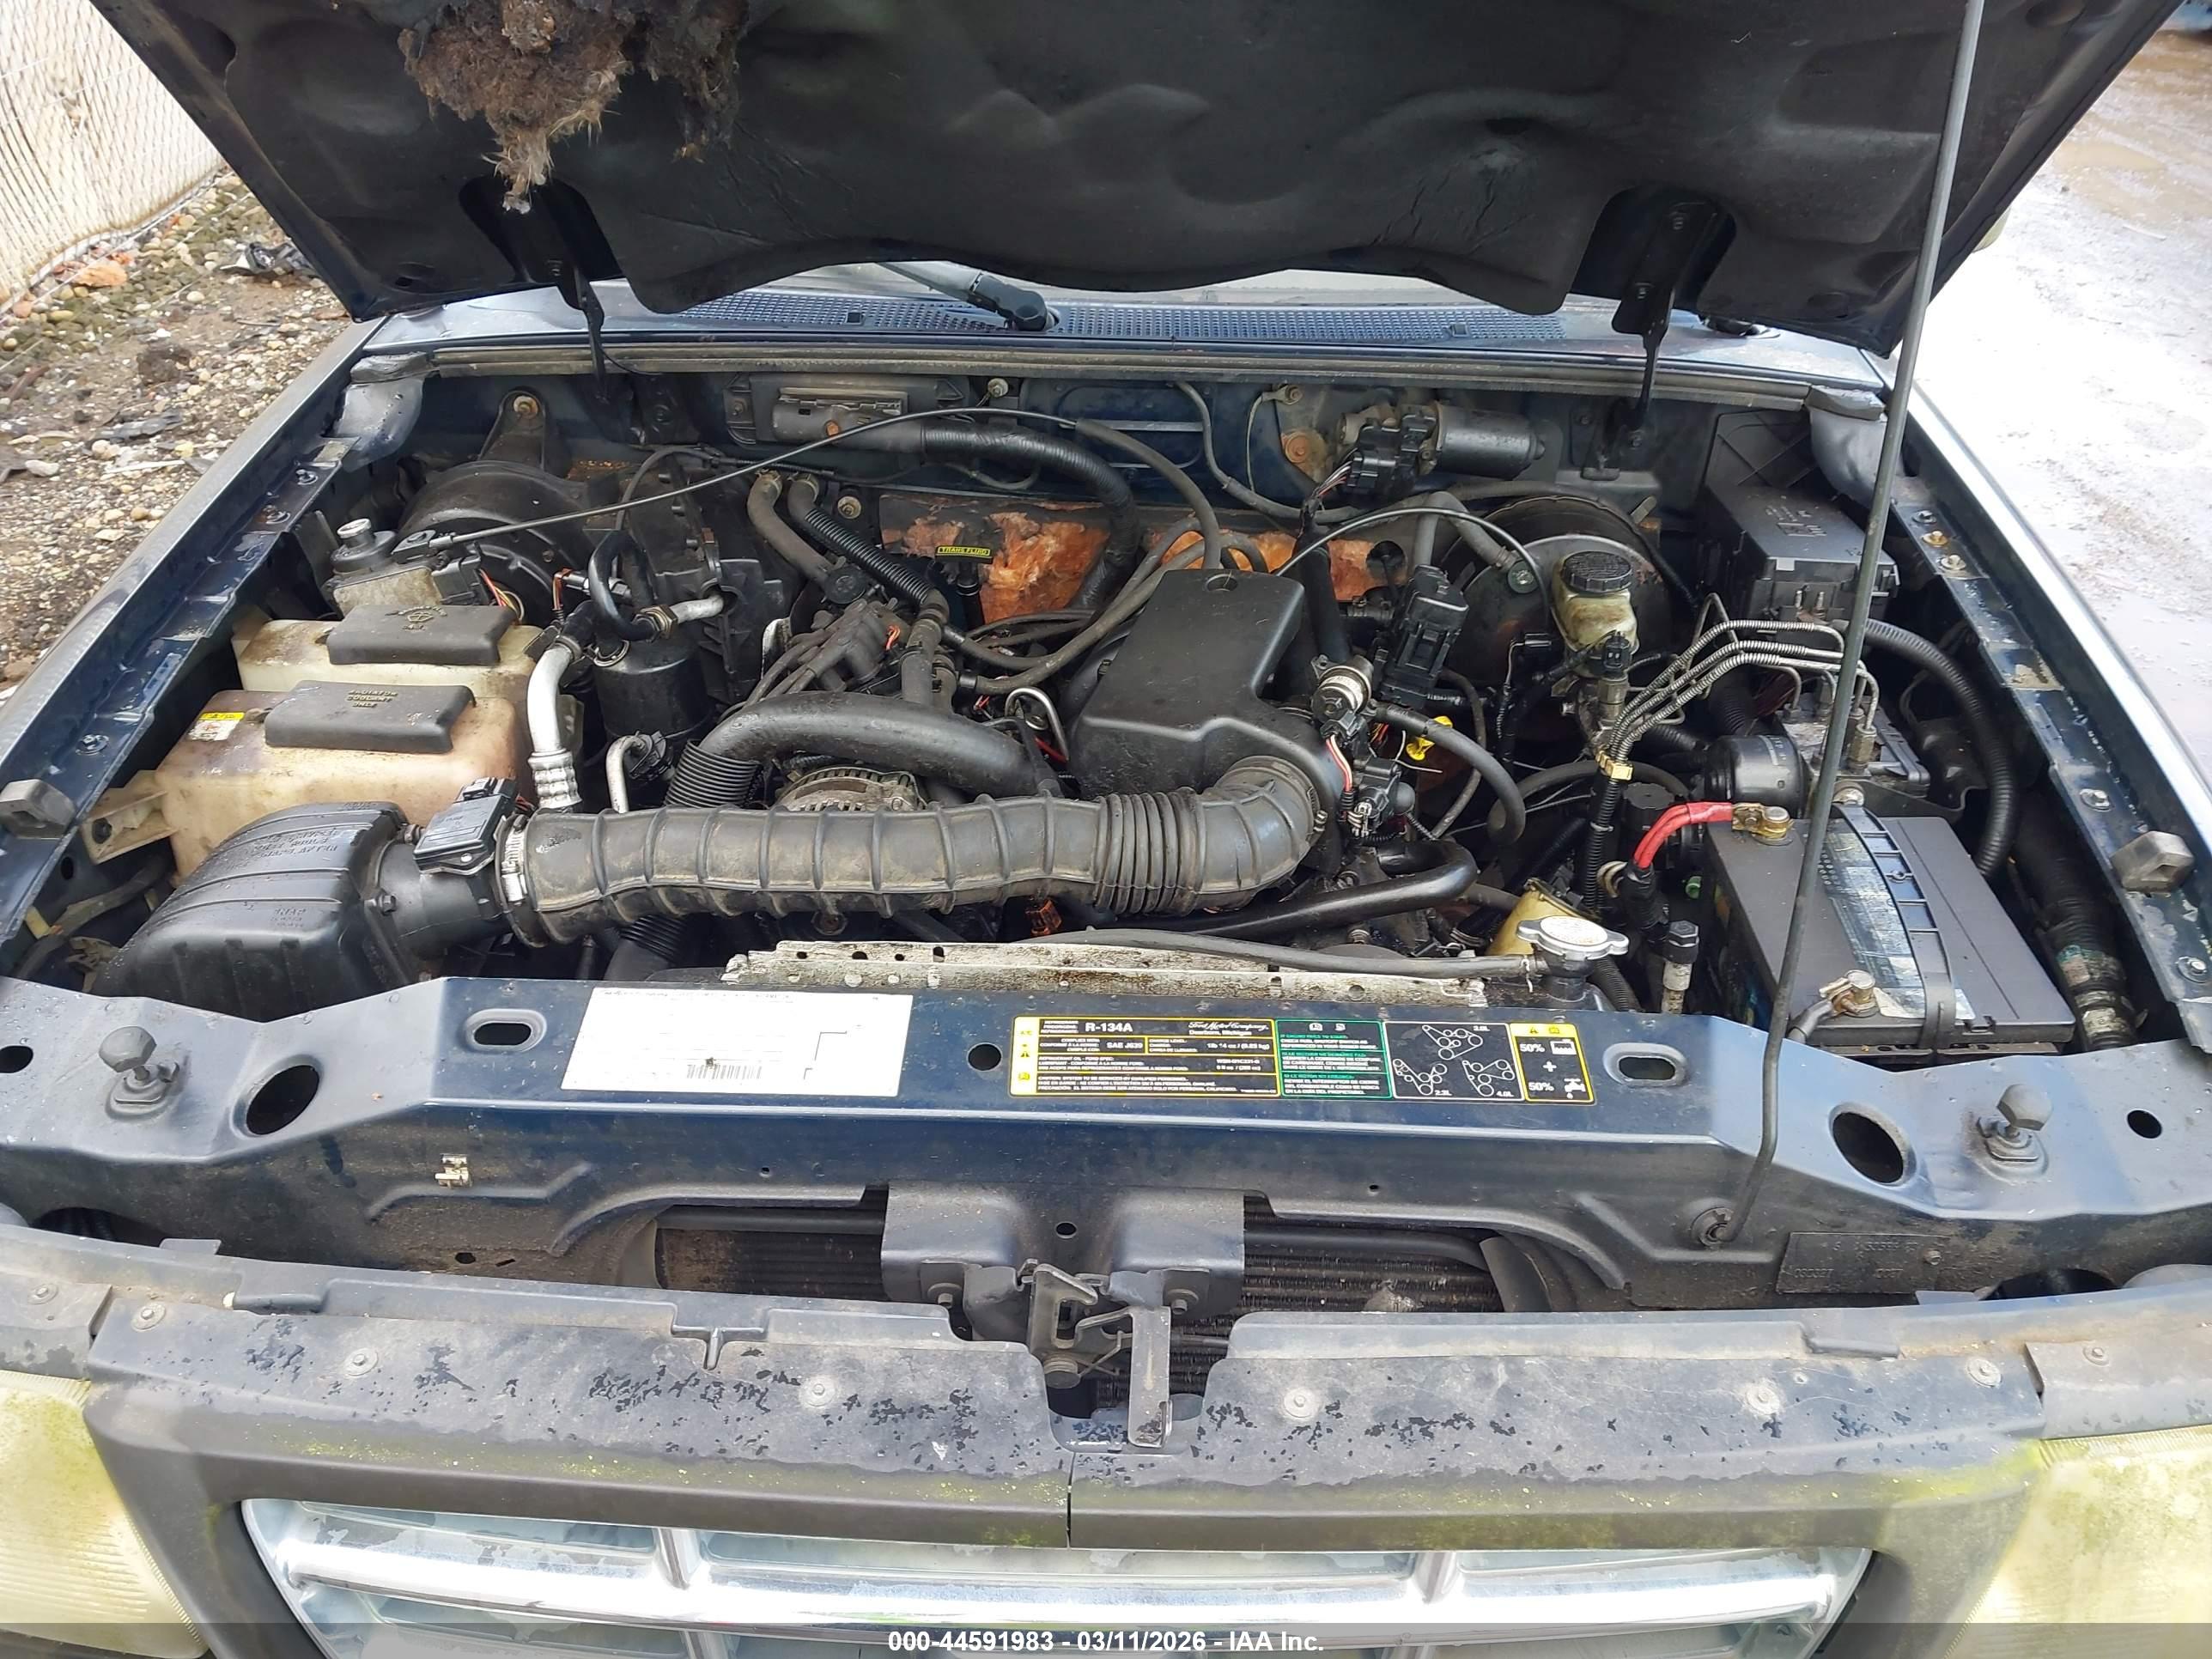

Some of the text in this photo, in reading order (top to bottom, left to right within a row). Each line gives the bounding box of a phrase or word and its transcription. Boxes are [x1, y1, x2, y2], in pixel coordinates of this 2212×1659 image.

[1085, 1022, 1133, 1032] R-134A
[1519, 1043, 1546, 1053] 50%
[1528, 1081, 1555, 1091] 50%
